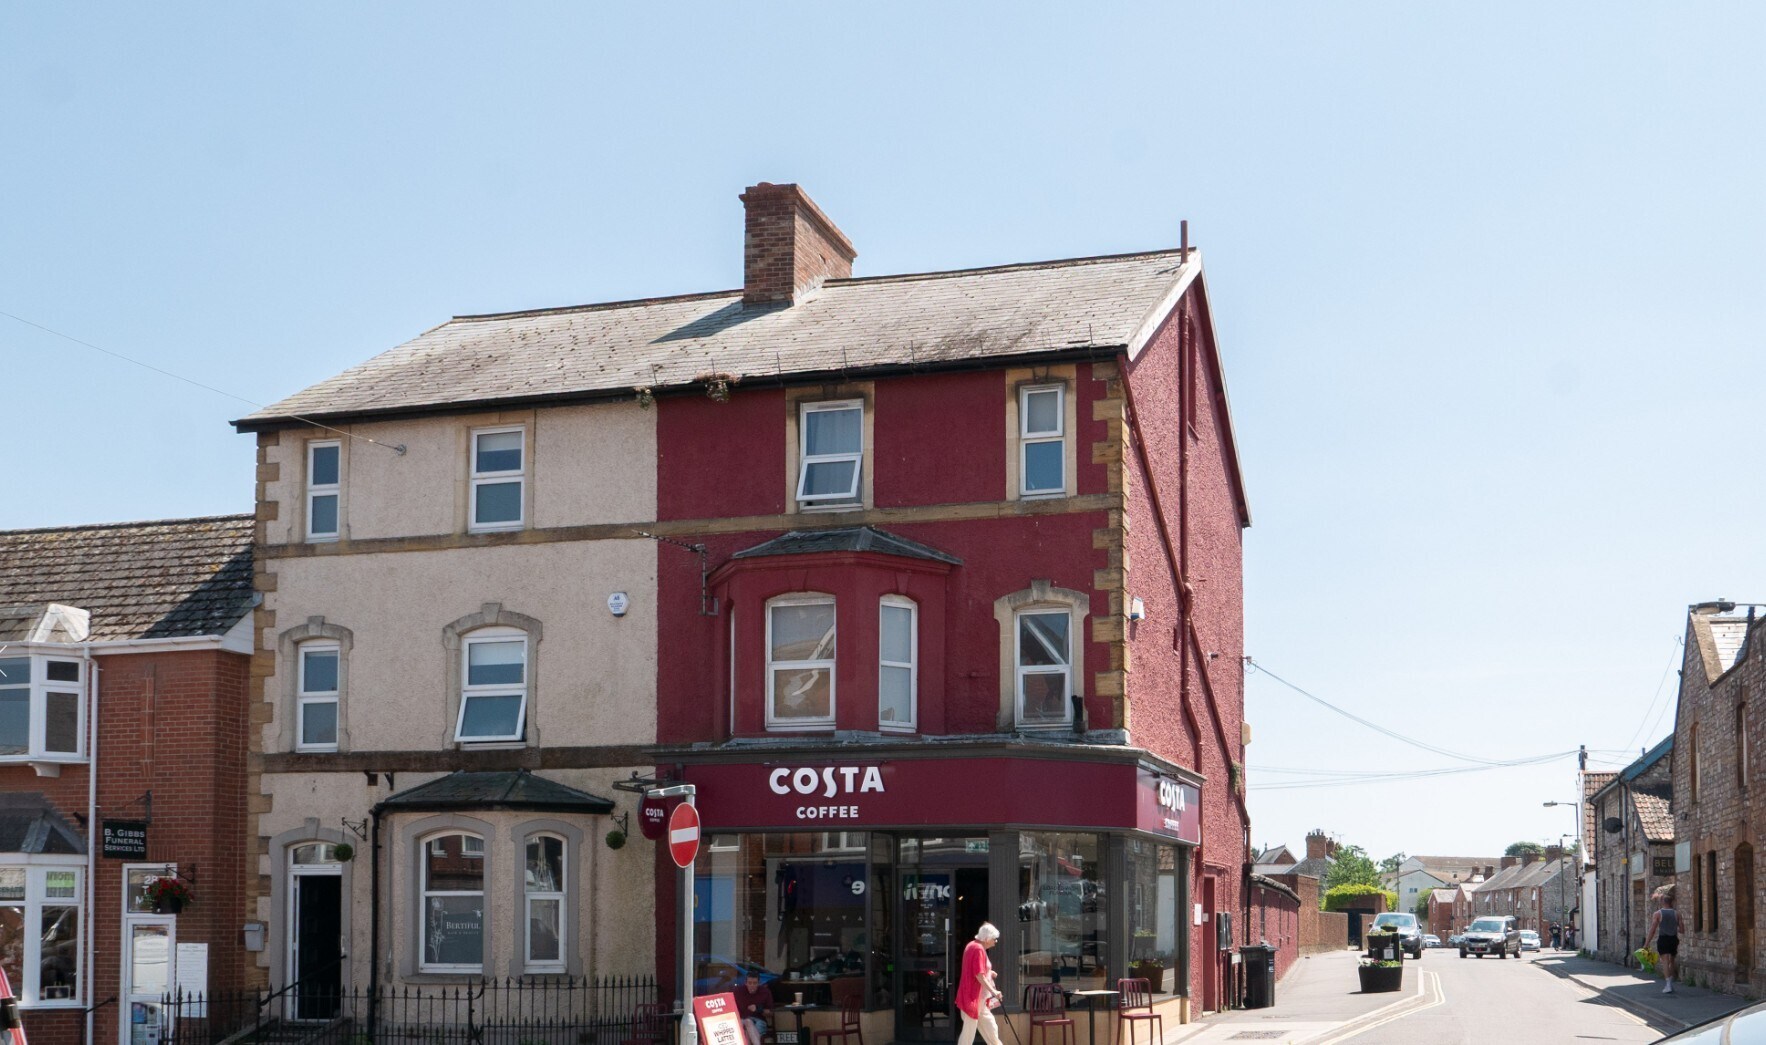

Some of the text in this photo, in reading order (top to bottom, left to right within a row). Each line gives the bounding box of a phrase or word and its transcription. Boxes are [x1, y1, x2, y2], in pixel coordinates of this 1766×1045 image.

[769, 766, 885, 798] COSTA
[1160, 780, 1186, 812] COSTA
[645, 808, 664, 818] COSTA
[796, 806, 859, 819] COFFEE
[104, 828, 145, 838] B. GIBBS
[105, 836, 144, 845] FUNERAL
[104, 844, 132, 852] SERVICES
[1655, 859, 1674, 867] BEL
[705, 998, 726, 1008] COSTA
